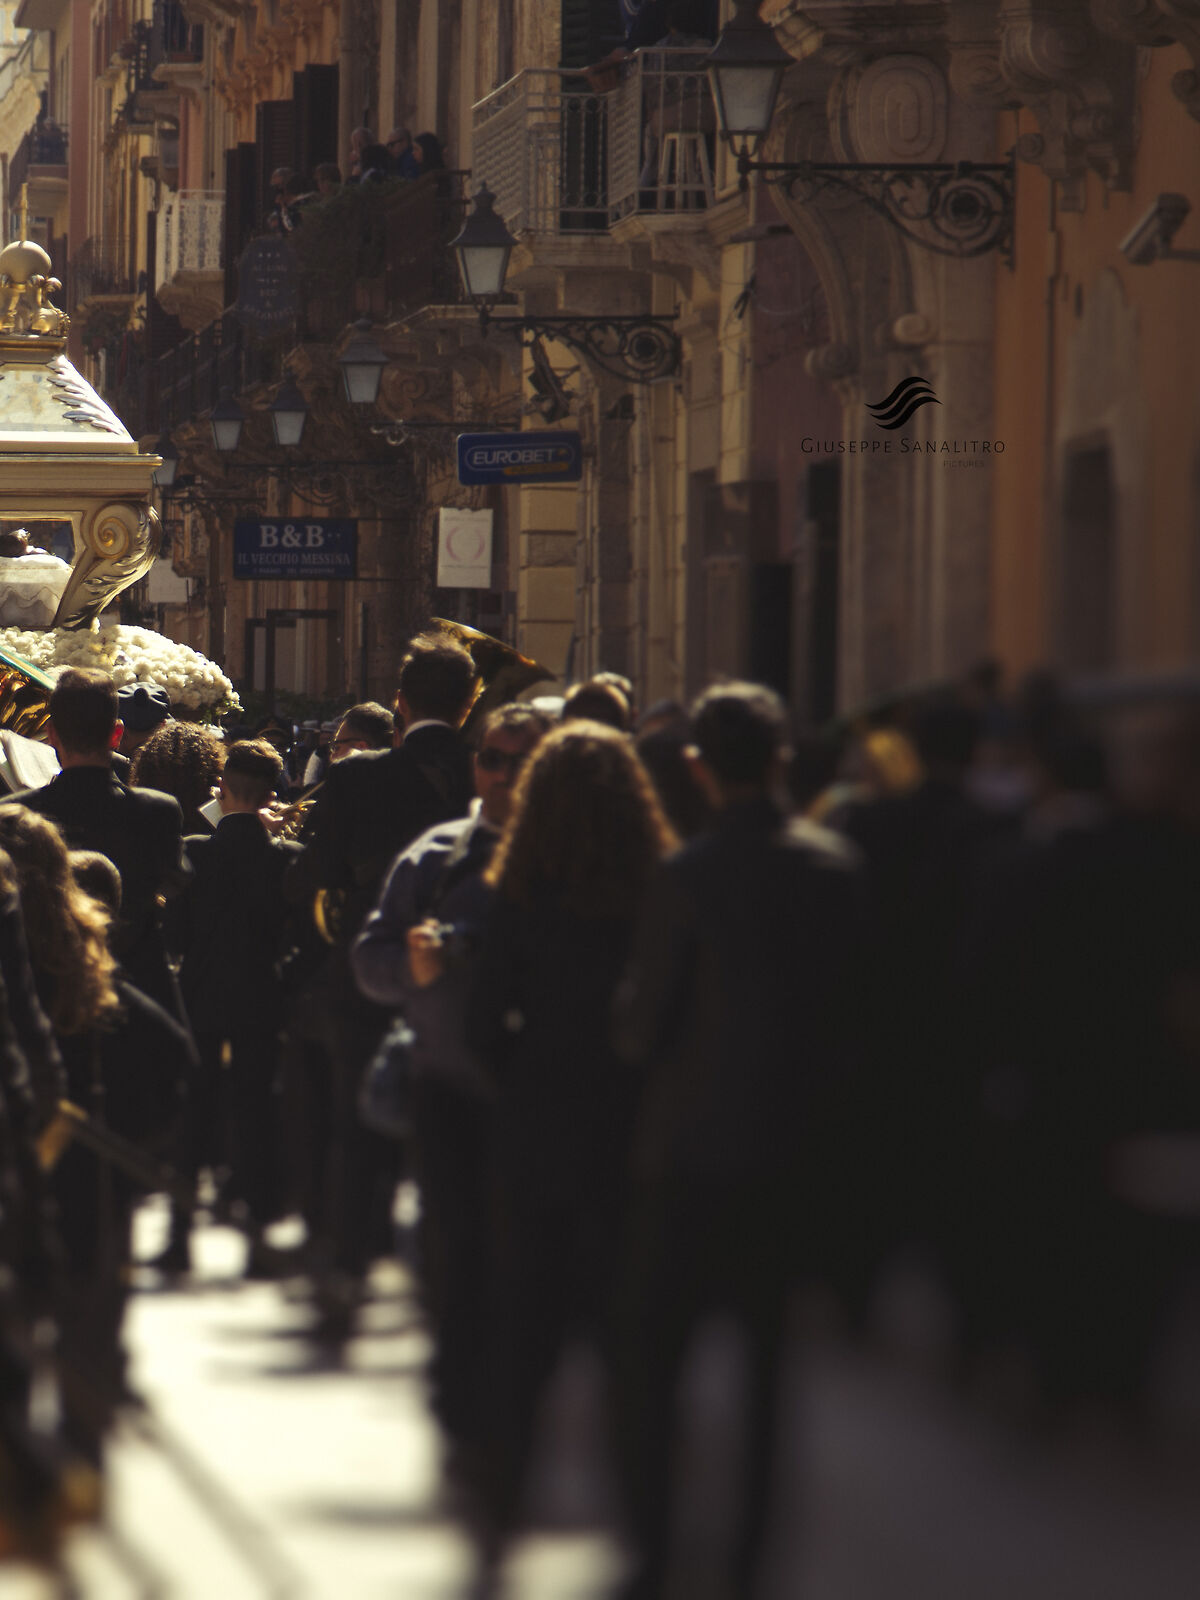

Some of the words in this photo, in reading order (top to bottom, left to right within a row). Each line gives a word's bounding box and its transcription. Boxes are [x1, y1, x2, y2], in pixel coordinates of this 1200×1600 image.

[472, 447, 553, 465] EUROBET
[258, 524, 325, 548] B&B
[237, 552, 249, 565] IL
[251, 552, 298, 565] VECCHIO
[301, 552, 351, 565] MESSINA
